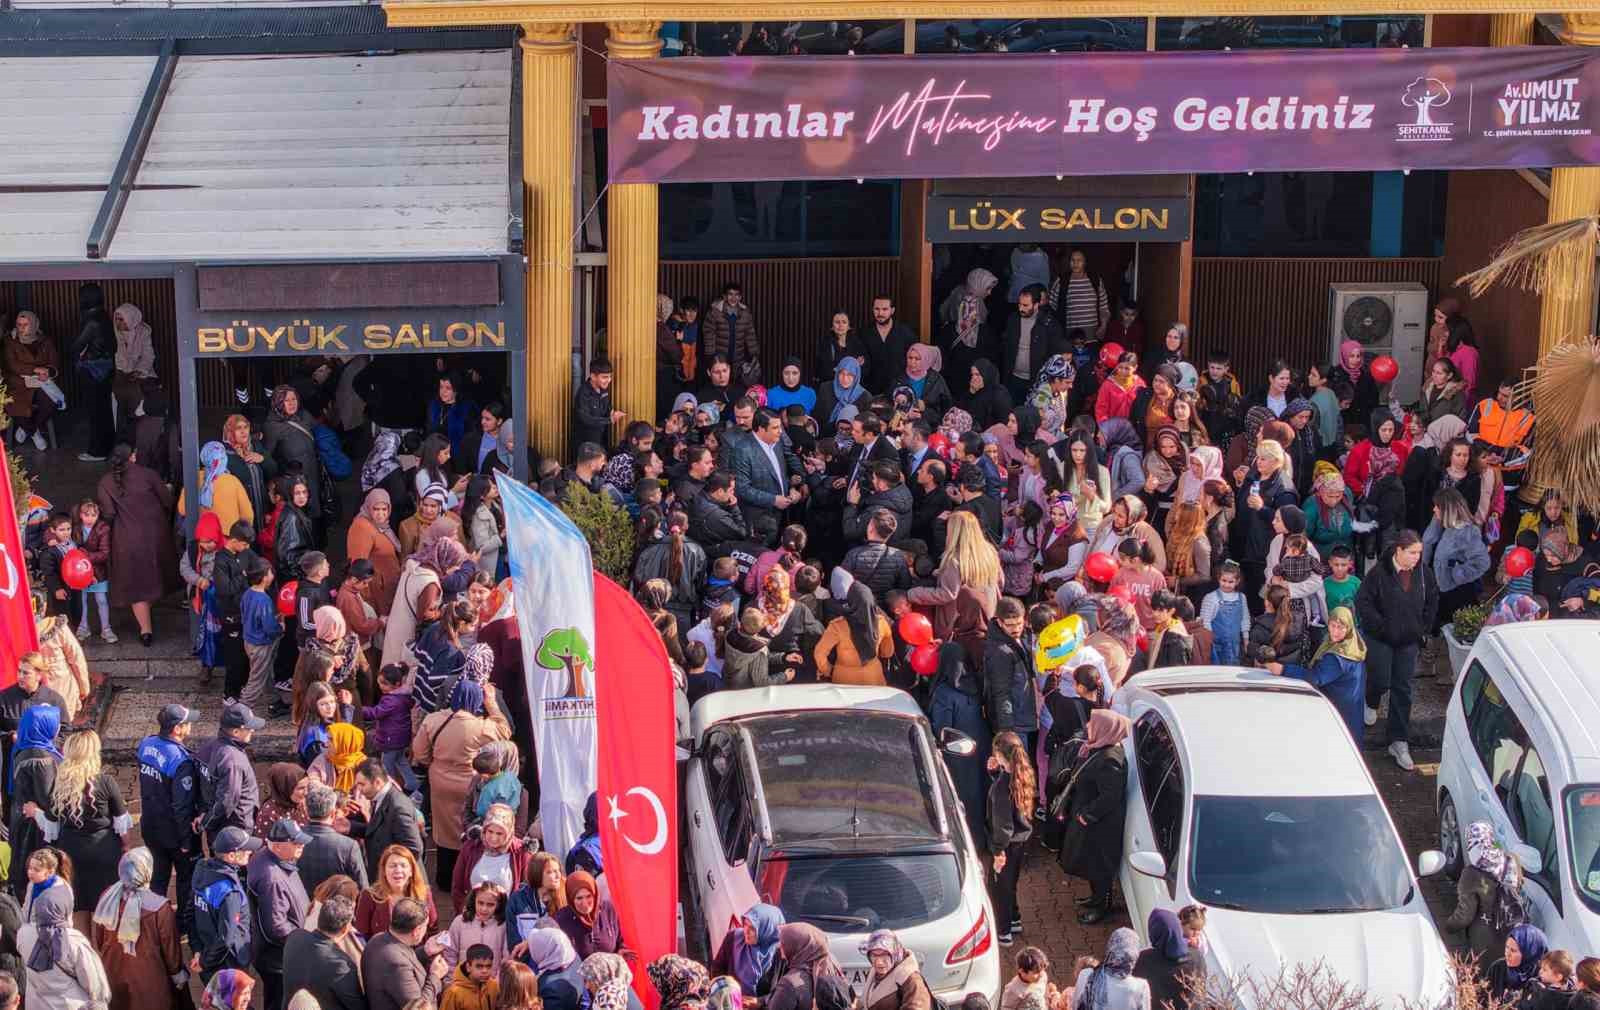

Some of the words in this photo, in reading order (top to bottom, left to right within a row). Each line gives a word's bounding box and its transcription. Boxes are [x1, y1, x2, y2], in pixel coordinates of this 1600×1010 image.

[638, 103, 855, 141] Kadınlar
[865, 78, 1057, 156] Matinesine
[1063, 98, 1159, 142] Hoş
[1173, 95, 1376, 131] Geldiniz
[1498, 98, 1581, 126] YILMAZ
[948, 202, 1026, 231] LÜX
[1039, 208, 1169, 231] SALON
[197, 319, 349, 352] BÜYÜK
[363, 321, 506, 349] SALON
